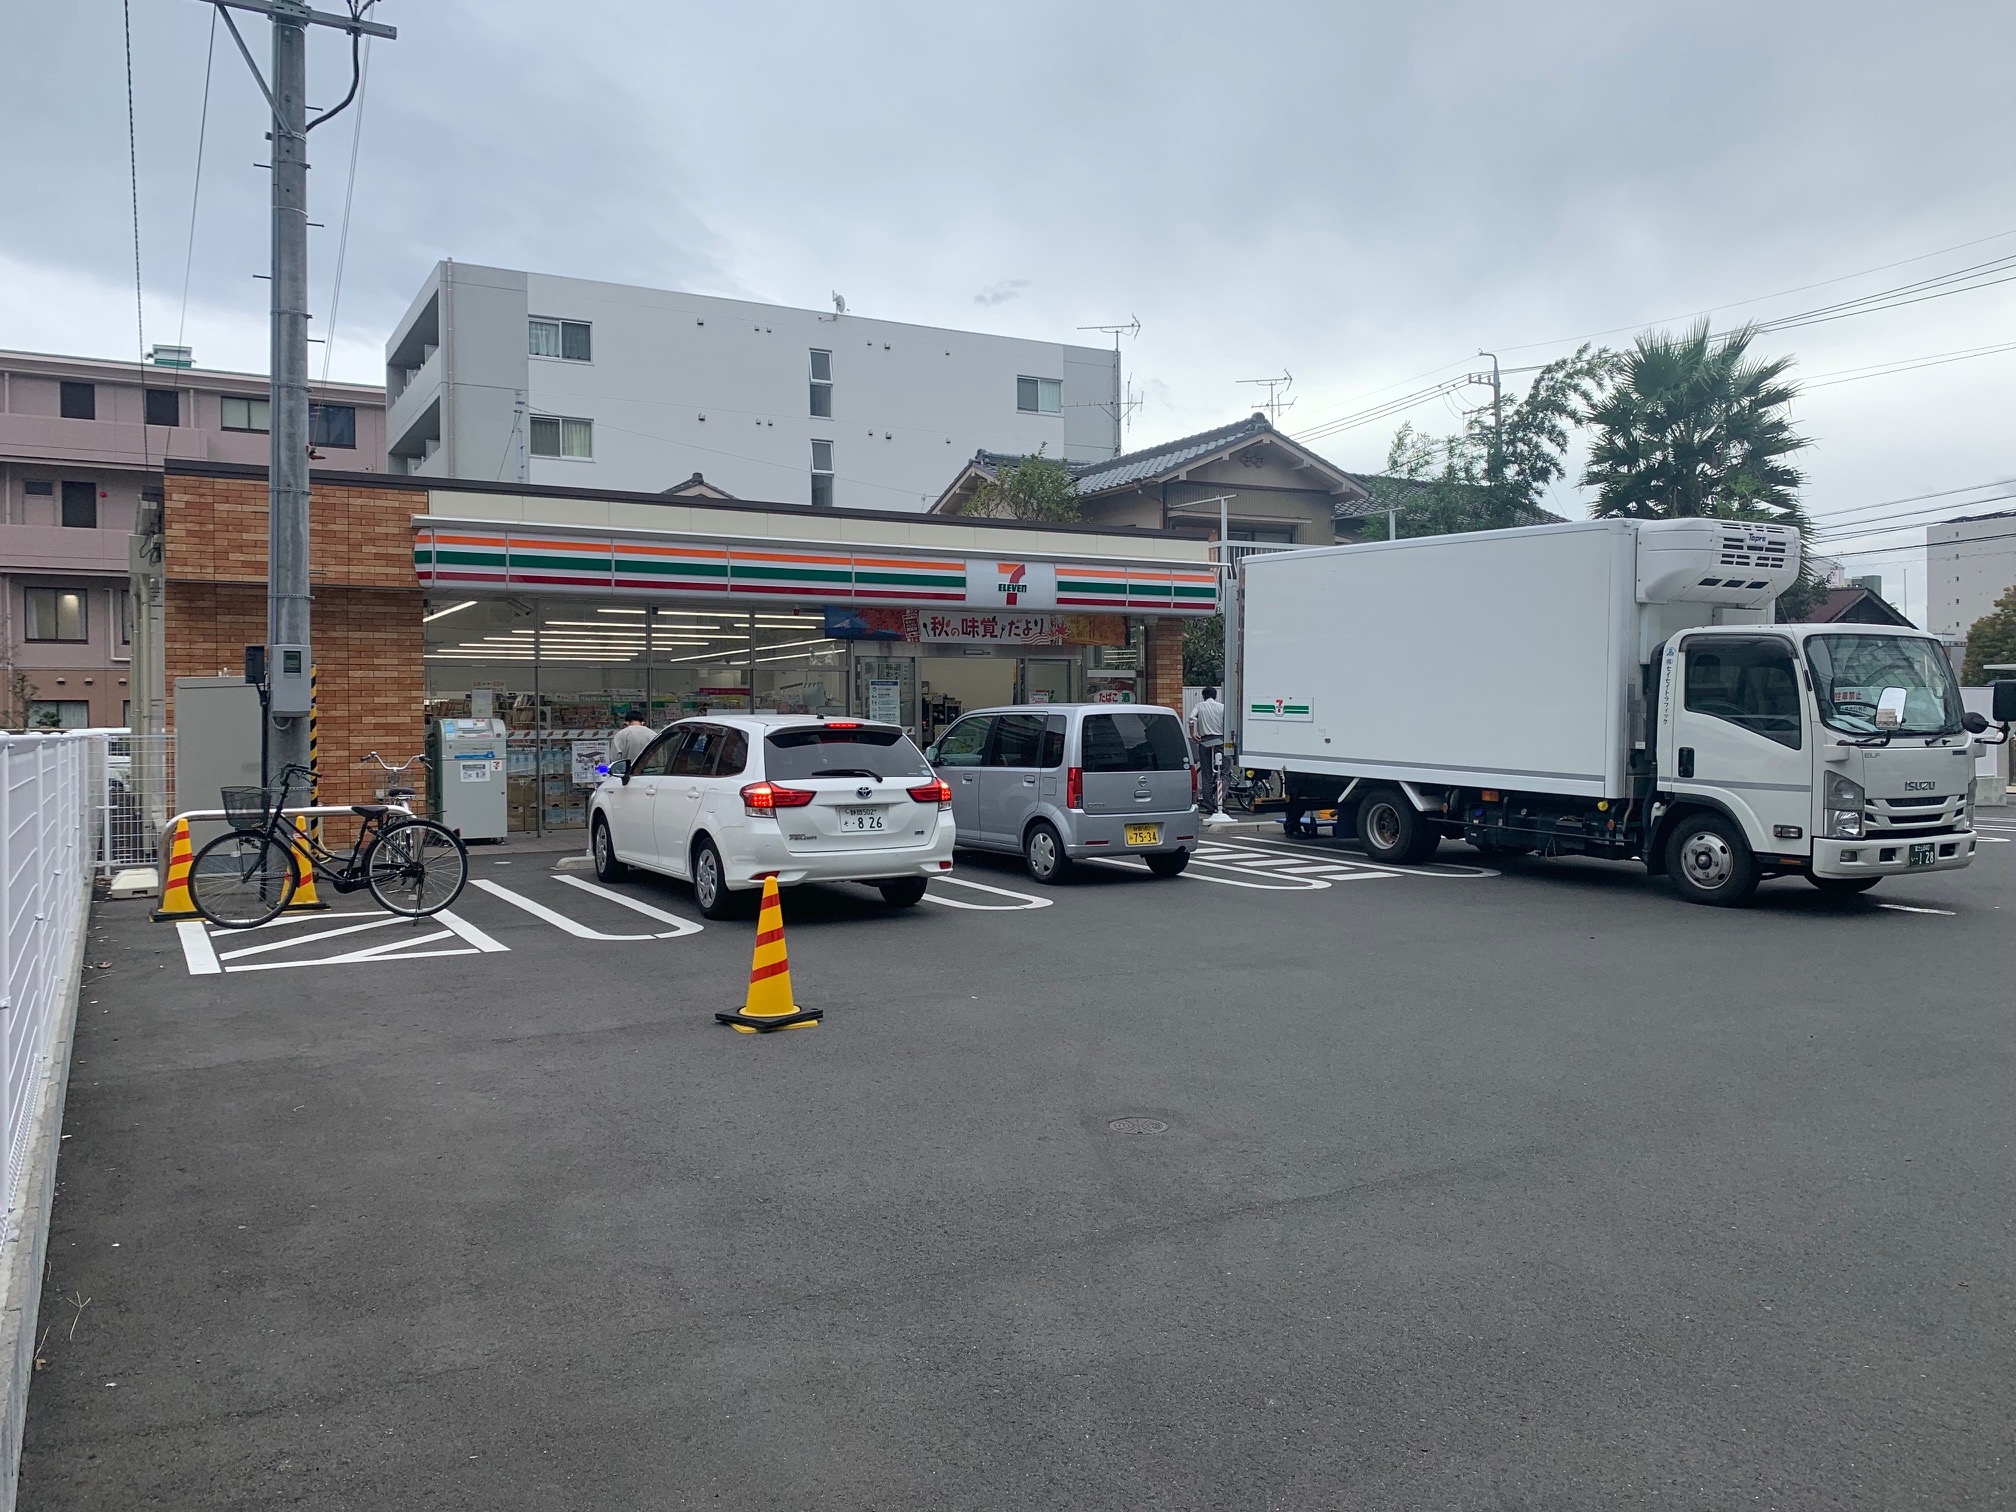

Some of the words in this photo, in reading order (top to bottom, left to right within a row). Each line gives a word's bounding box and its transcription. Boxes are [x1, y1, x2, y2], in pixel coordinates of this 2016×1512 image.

[1749, 533, 1766, 542] Topre
[1098, 692, 1119, 703] たばこ
[1121, 692, 1131, 703] 酒
[1904, 781, 1936, 791] ISUZU
